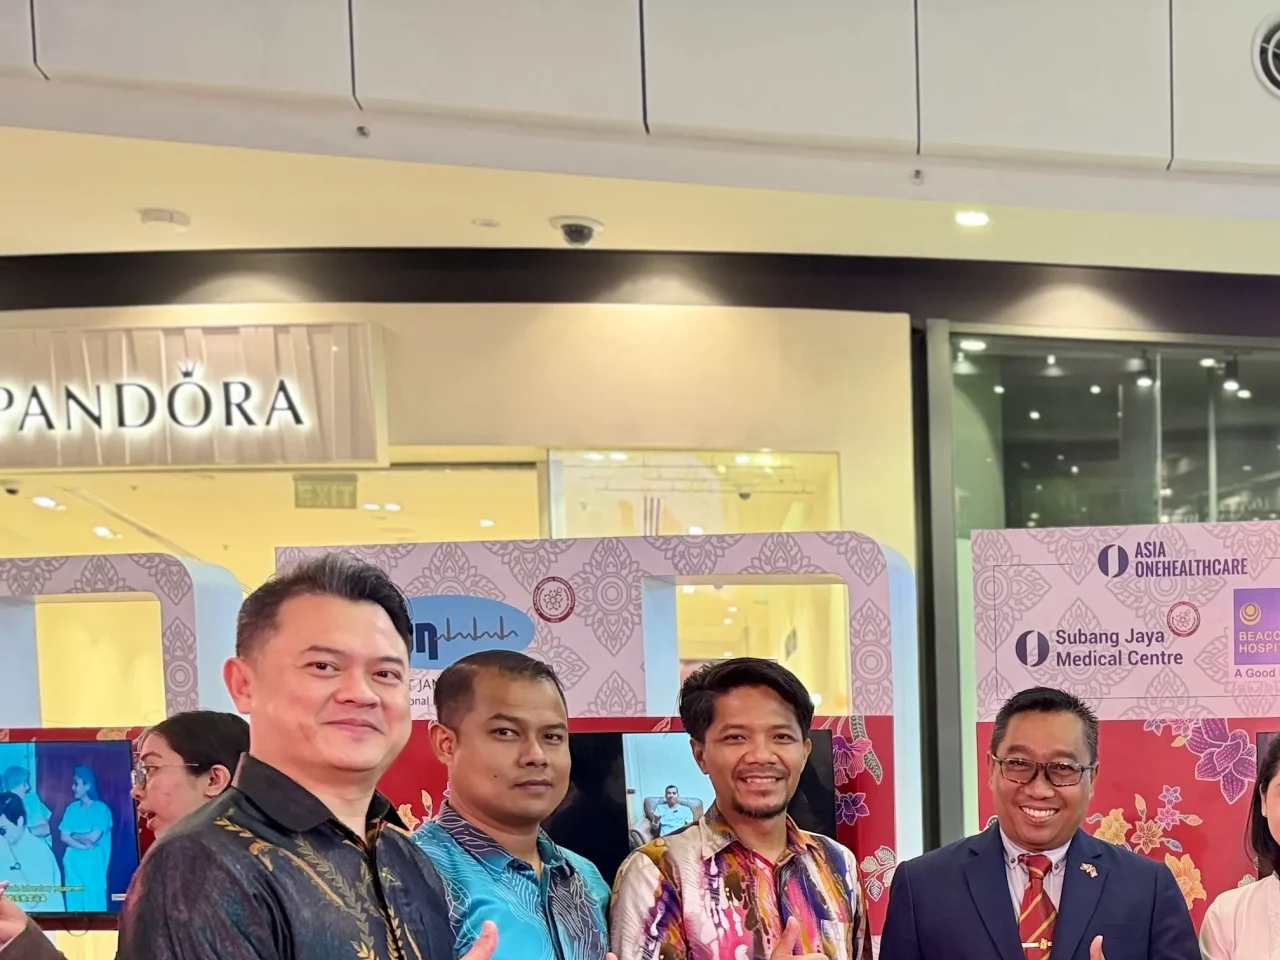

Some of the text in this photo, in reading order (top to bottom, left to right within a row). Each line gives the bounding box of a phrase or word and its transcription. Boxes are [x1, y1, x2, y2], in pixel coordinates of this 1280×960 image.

[1135, 541, 1166, 558] ASIA
[1135, 558, 1248, 577] ONEHEALTHCARE
[1056, 628, 1165, 647] Subang Jaya
[1056, 650, 1183, 667] Medical Centre
[1234, 668, 1243, 678] A
[1246, 668, 1276, 678] Good
